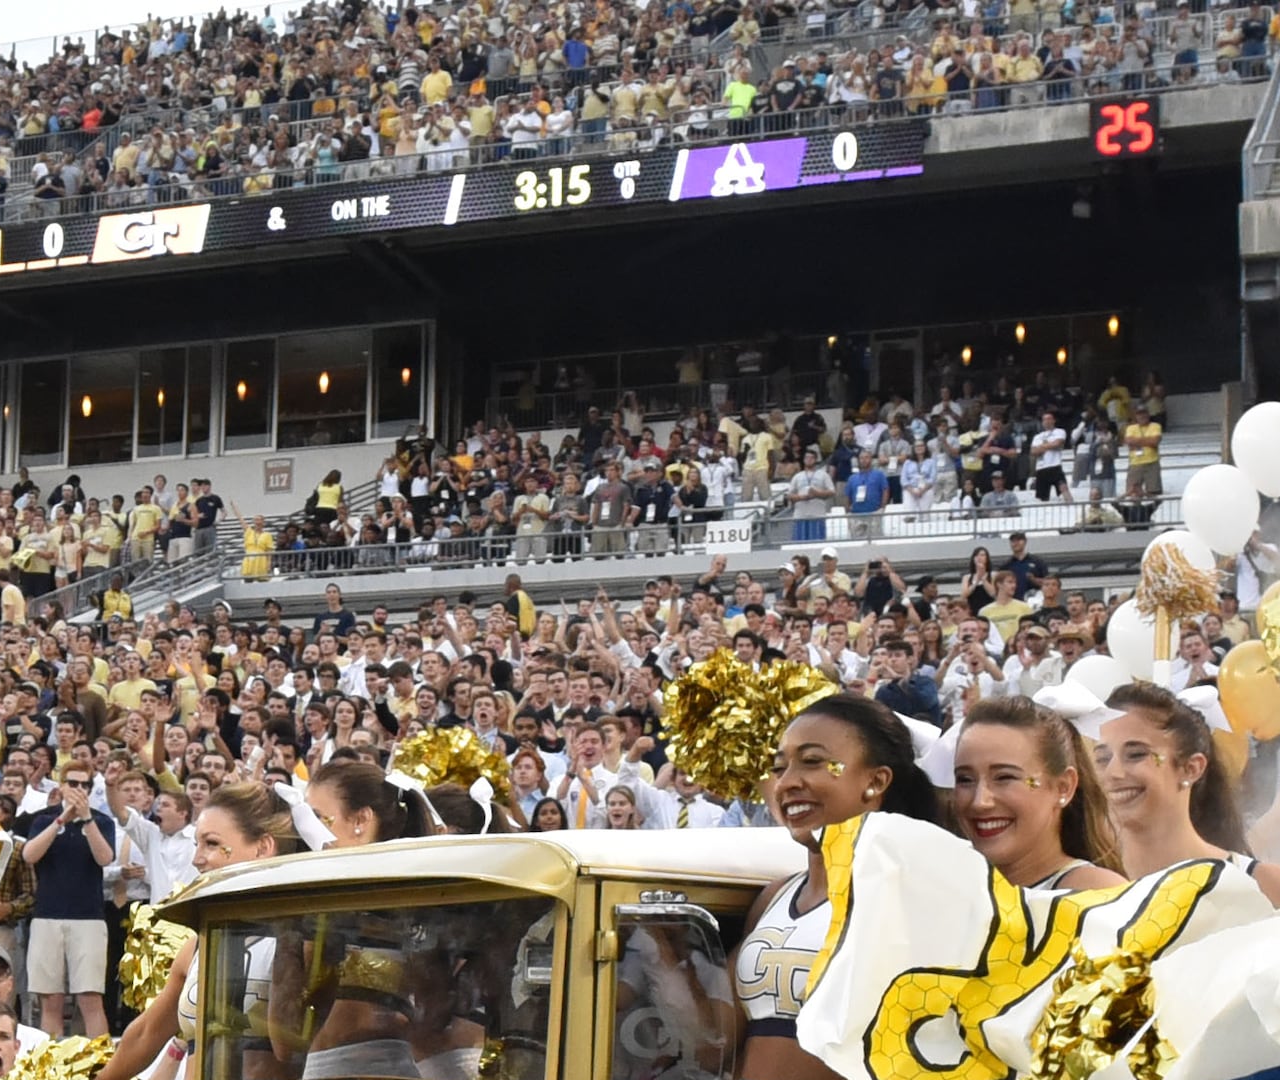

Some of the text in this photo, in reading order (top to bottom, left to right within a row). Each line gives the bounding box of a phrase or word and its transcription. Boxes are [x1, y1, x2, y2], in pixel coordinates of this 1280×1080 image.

[1096, 101, 1154, 155] 25
[833, 132, 857, 170] 0
[614, 161, 641, 178] QTR
[514, 165, 592, 210] 3:15
[331, 199, 357, 221] ON
[360, 195, 390, 216] THE
[43, 223, 64, 257] 0
[269, 473, 288, 487] 117
[708, 528, 750, 543] 118U
